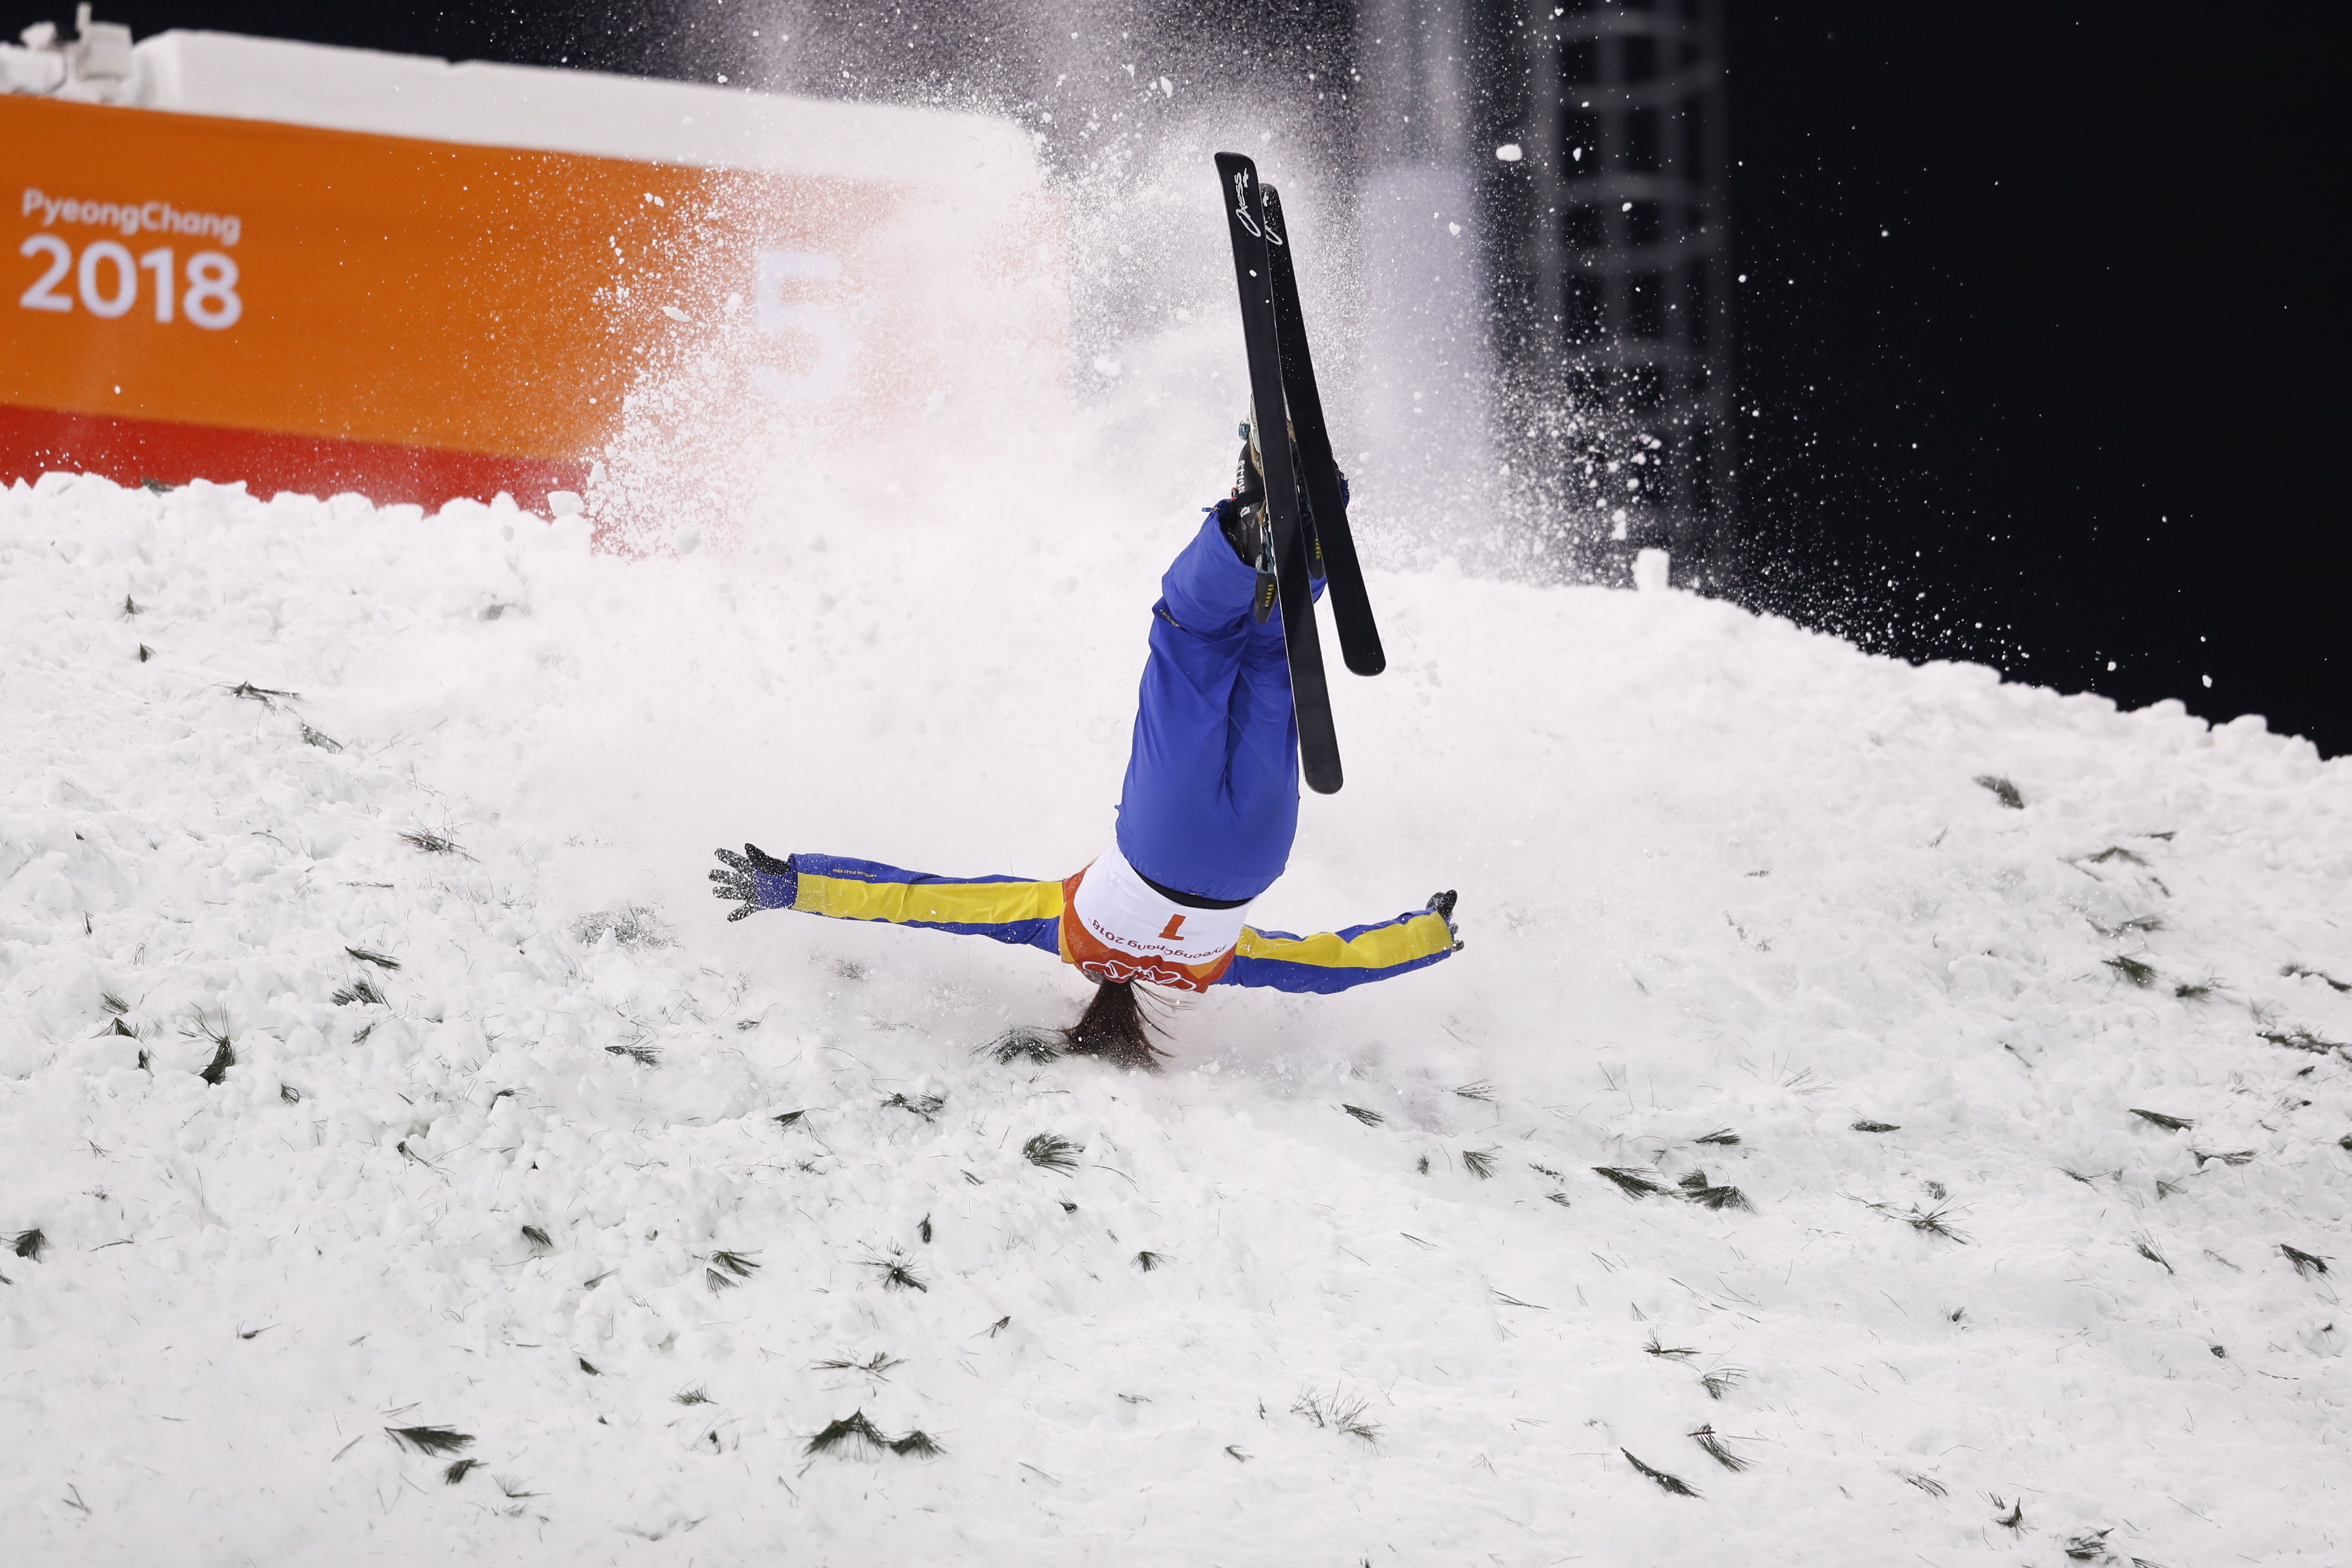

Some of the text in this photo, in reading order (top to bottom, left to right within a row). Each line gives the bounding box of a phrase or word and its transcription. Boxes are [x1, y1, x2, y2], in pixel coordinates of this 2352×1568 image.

[23, 188, 242, 246] PyeongChang
[19, 233, 242, 331] 2018
[750, 248, 852, 400] 5
[1093, 919, 1227, 959] PyeongChang 2018
